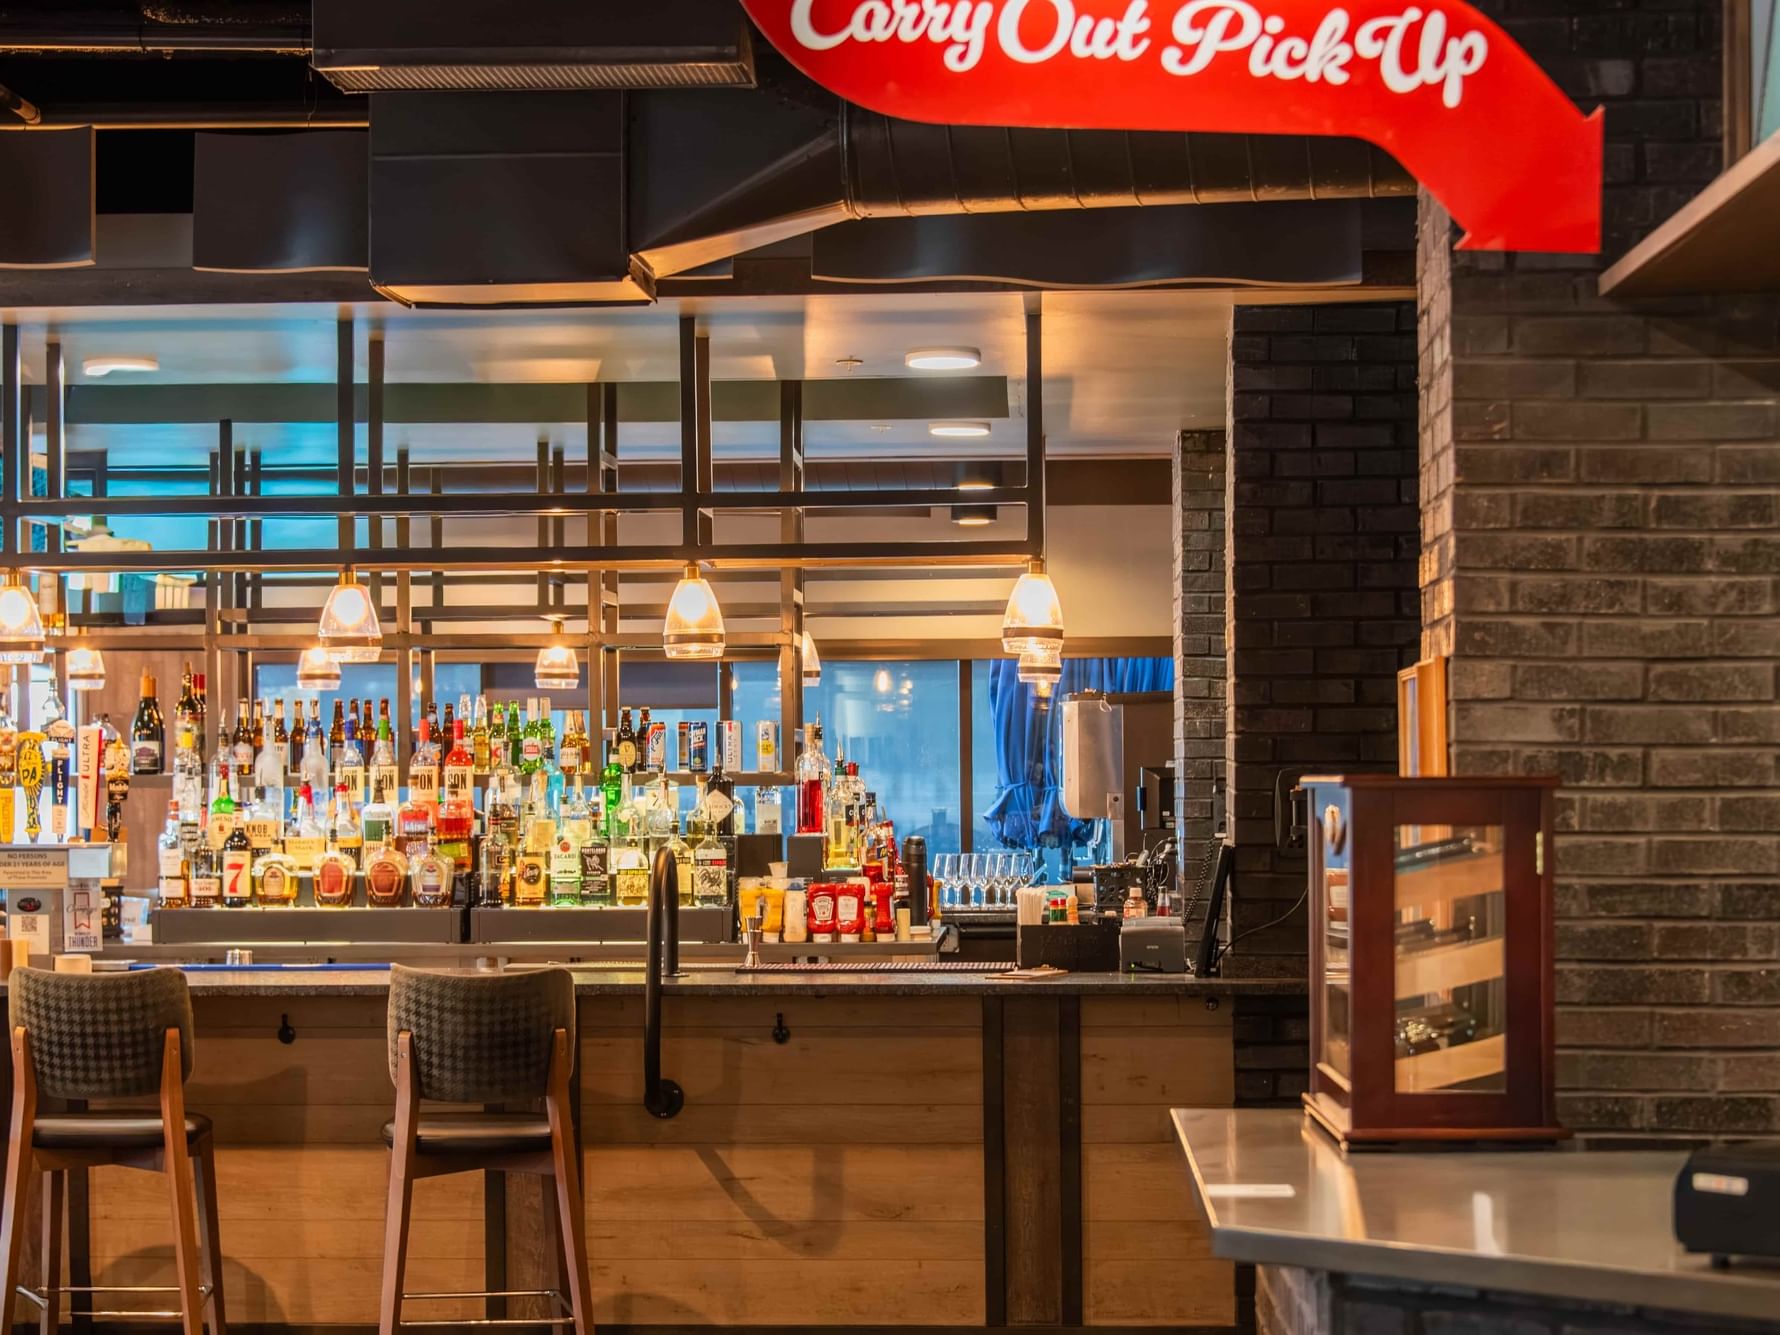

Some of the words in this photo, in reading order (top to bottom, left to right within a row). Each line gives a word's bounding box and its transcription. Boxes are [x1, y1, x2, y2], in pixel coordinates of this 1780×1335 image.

[791, 0, 994, 73] Carry
[998, 0, 1151, 63] Out
[1161, 0, 1353, 85] Pick
[1353, 8, 1487, 108] Up
[419, 774, 433, 790] ON
[245, 823, 268, 833] KNOB
[226, 863, 245, 894] 7
[68, 935, 98, 948] THUNDER
